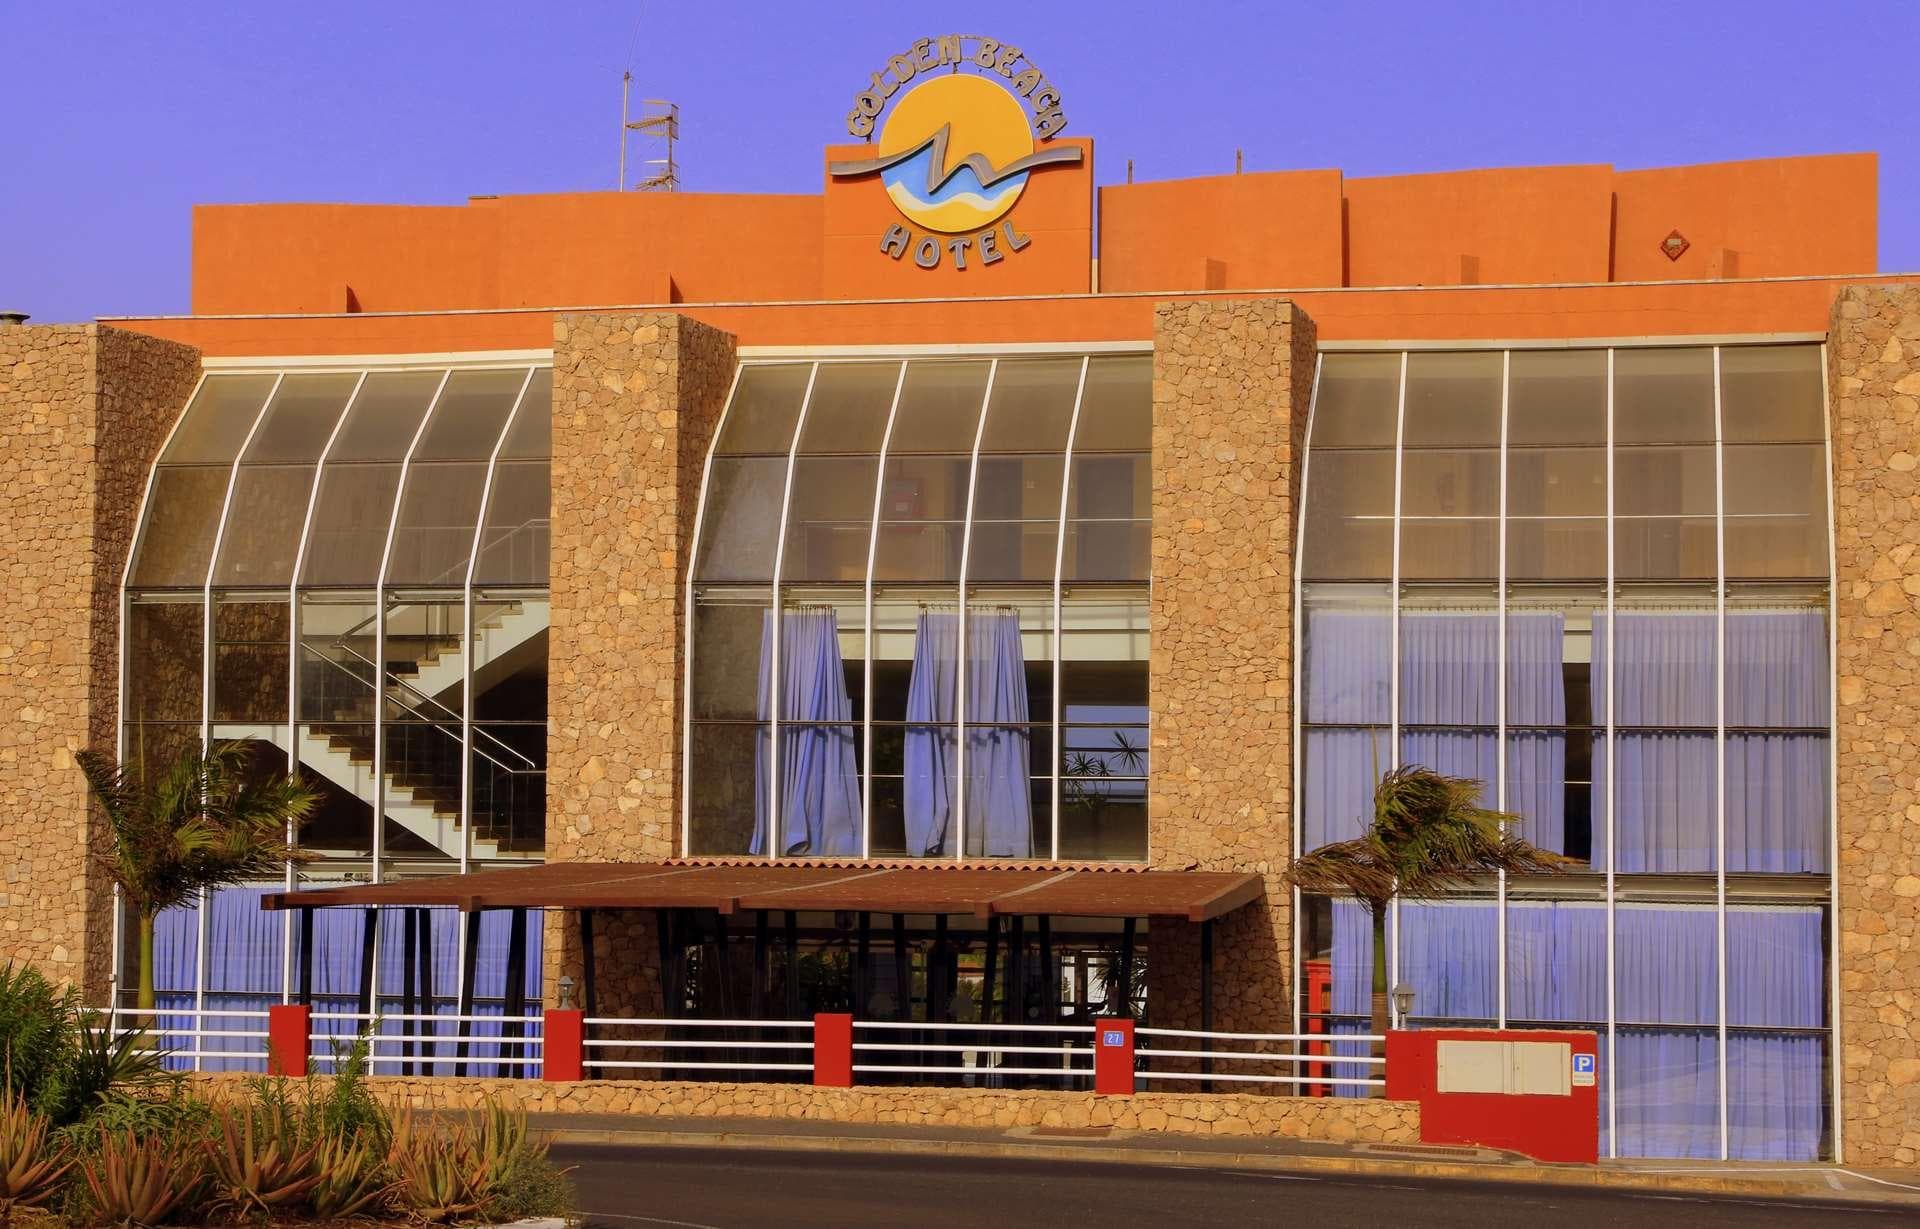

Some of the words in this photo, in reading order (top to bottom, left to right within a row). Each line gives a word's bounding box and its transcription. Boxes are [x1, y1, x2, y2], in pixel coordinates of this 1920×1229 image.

[847, 34, 961, 138] GOLDEN
[976, 36, 1068, 141] BEACH
[880, 219, 1032, 270] HOTEL
[1107, 1033, 1120, 1044] 27
[1578, 1056, 1591, 1071] P
